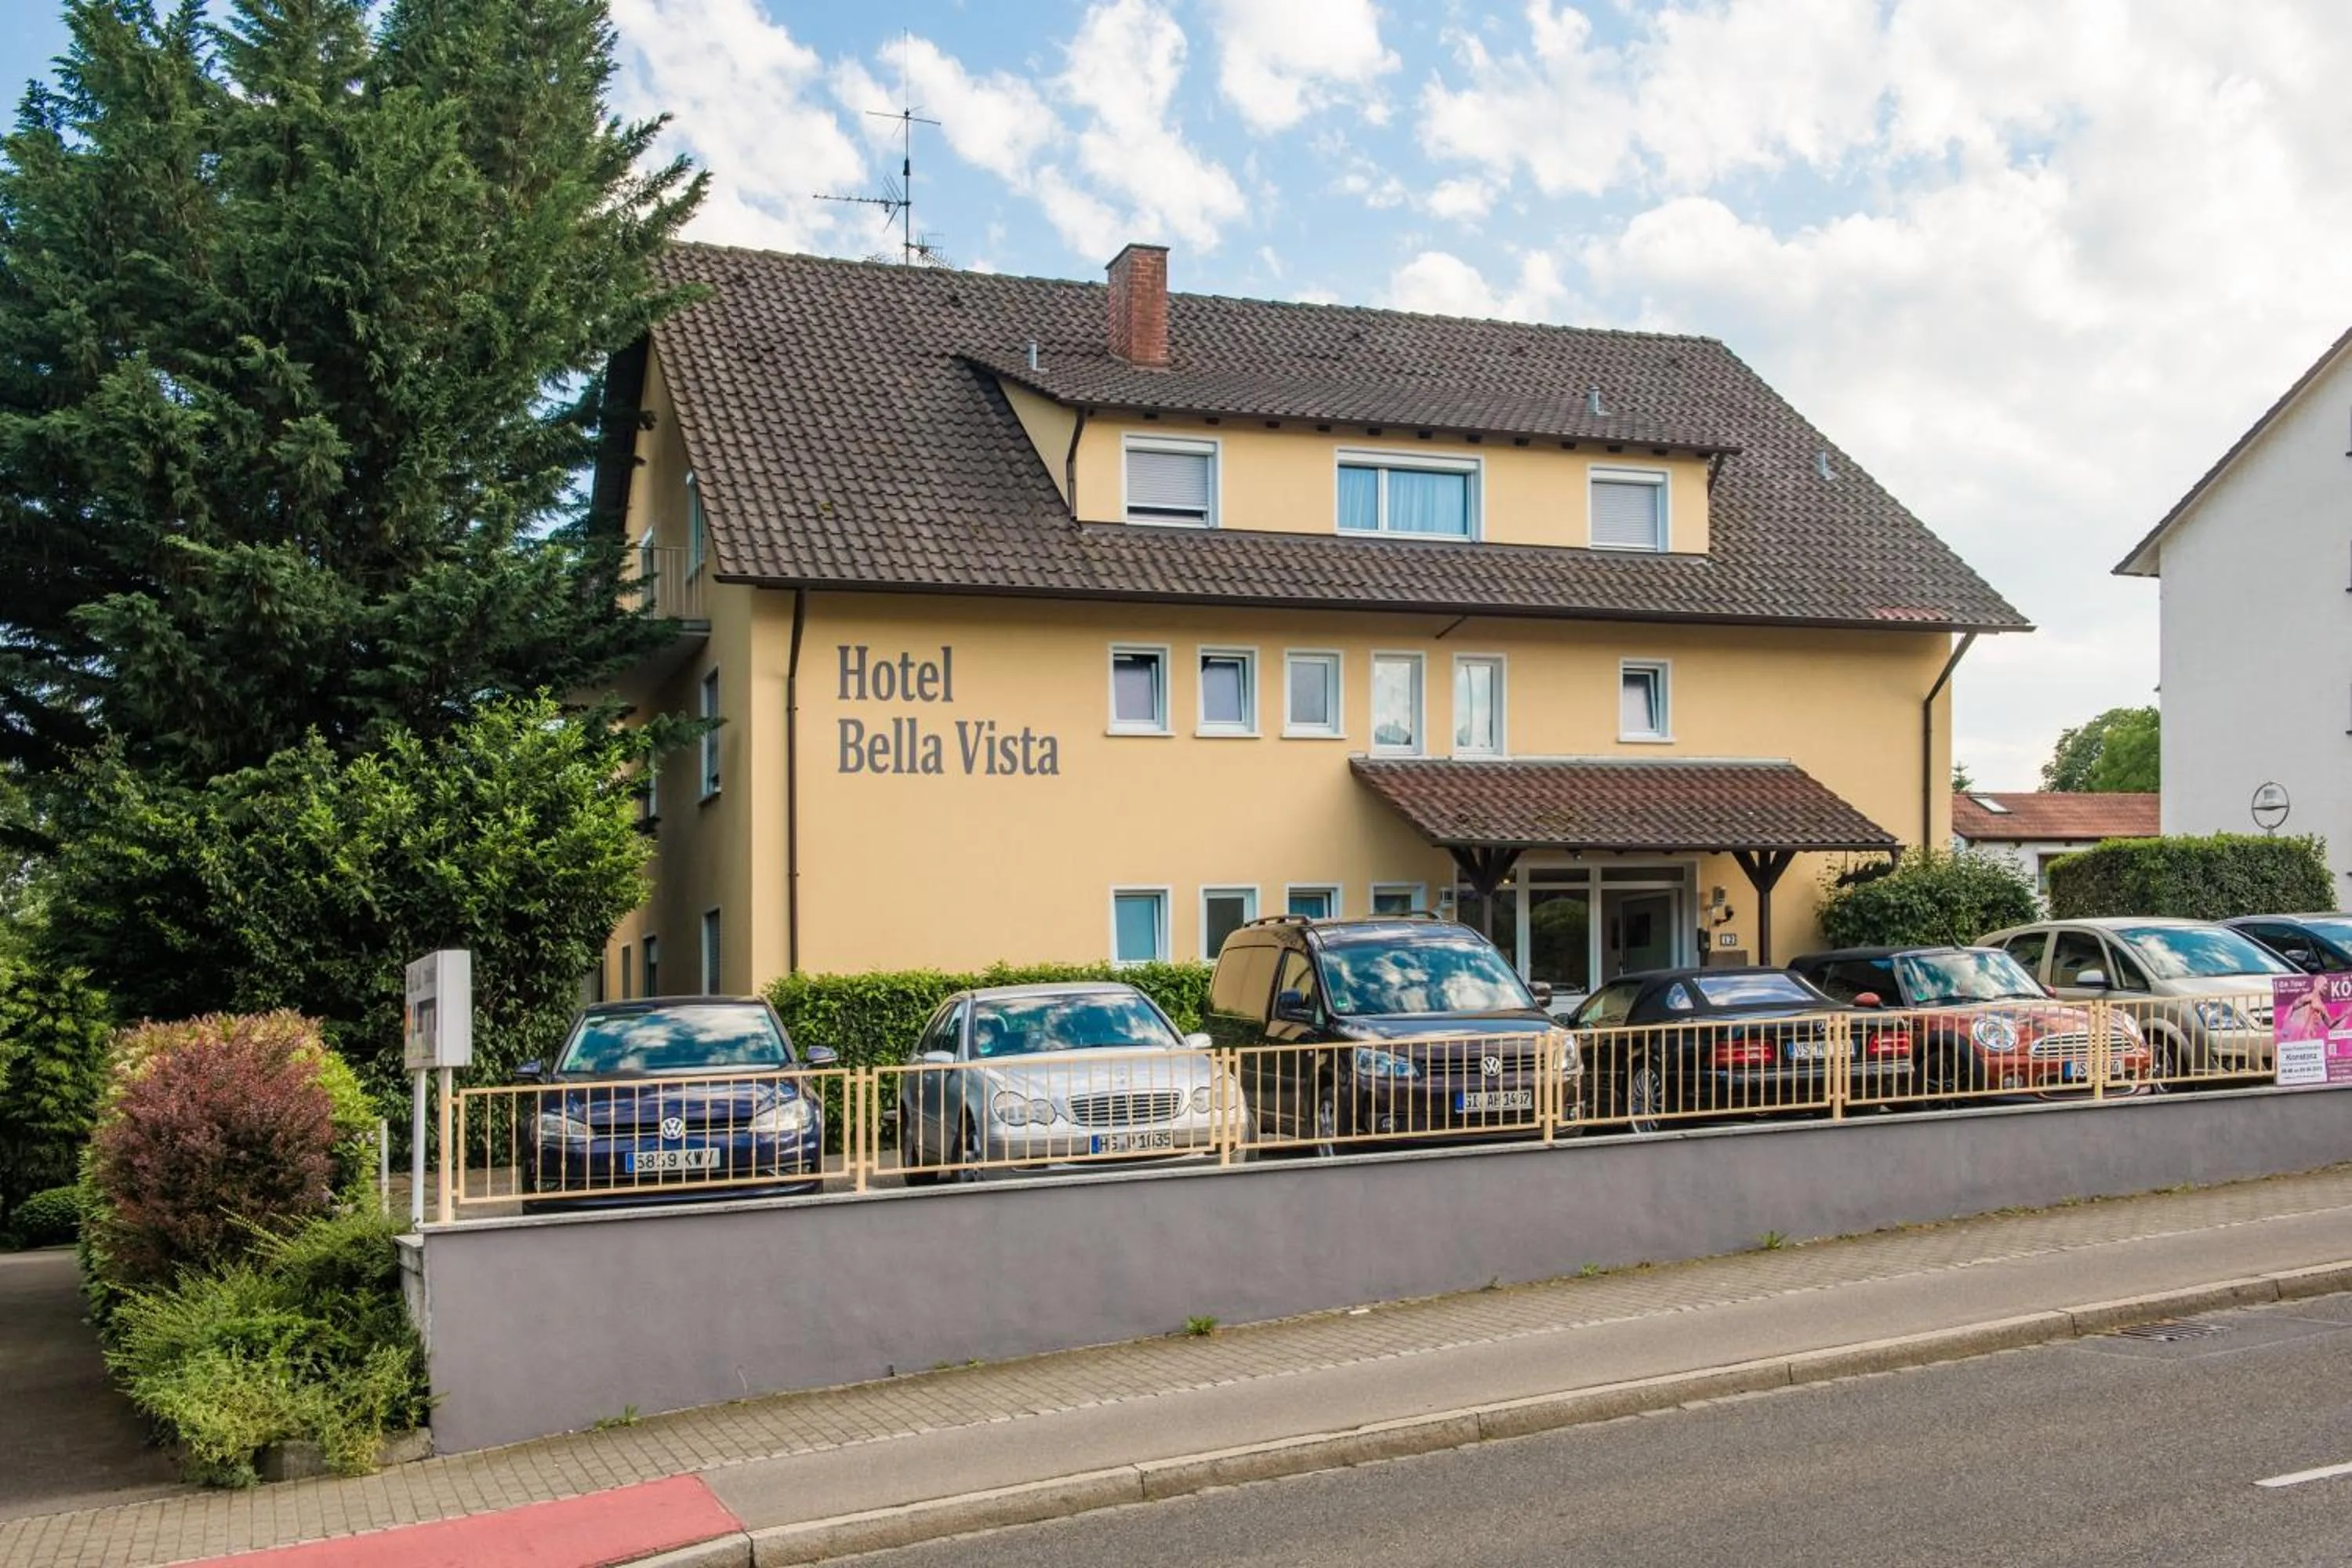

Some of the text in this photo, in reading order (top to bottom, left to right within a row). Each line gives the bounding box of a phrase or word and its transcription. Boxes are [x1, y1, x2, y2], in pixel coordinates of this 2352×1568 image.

[837, 645, 954, 702] Hotel
[837, 717, 1060, 775] Bella Vista
